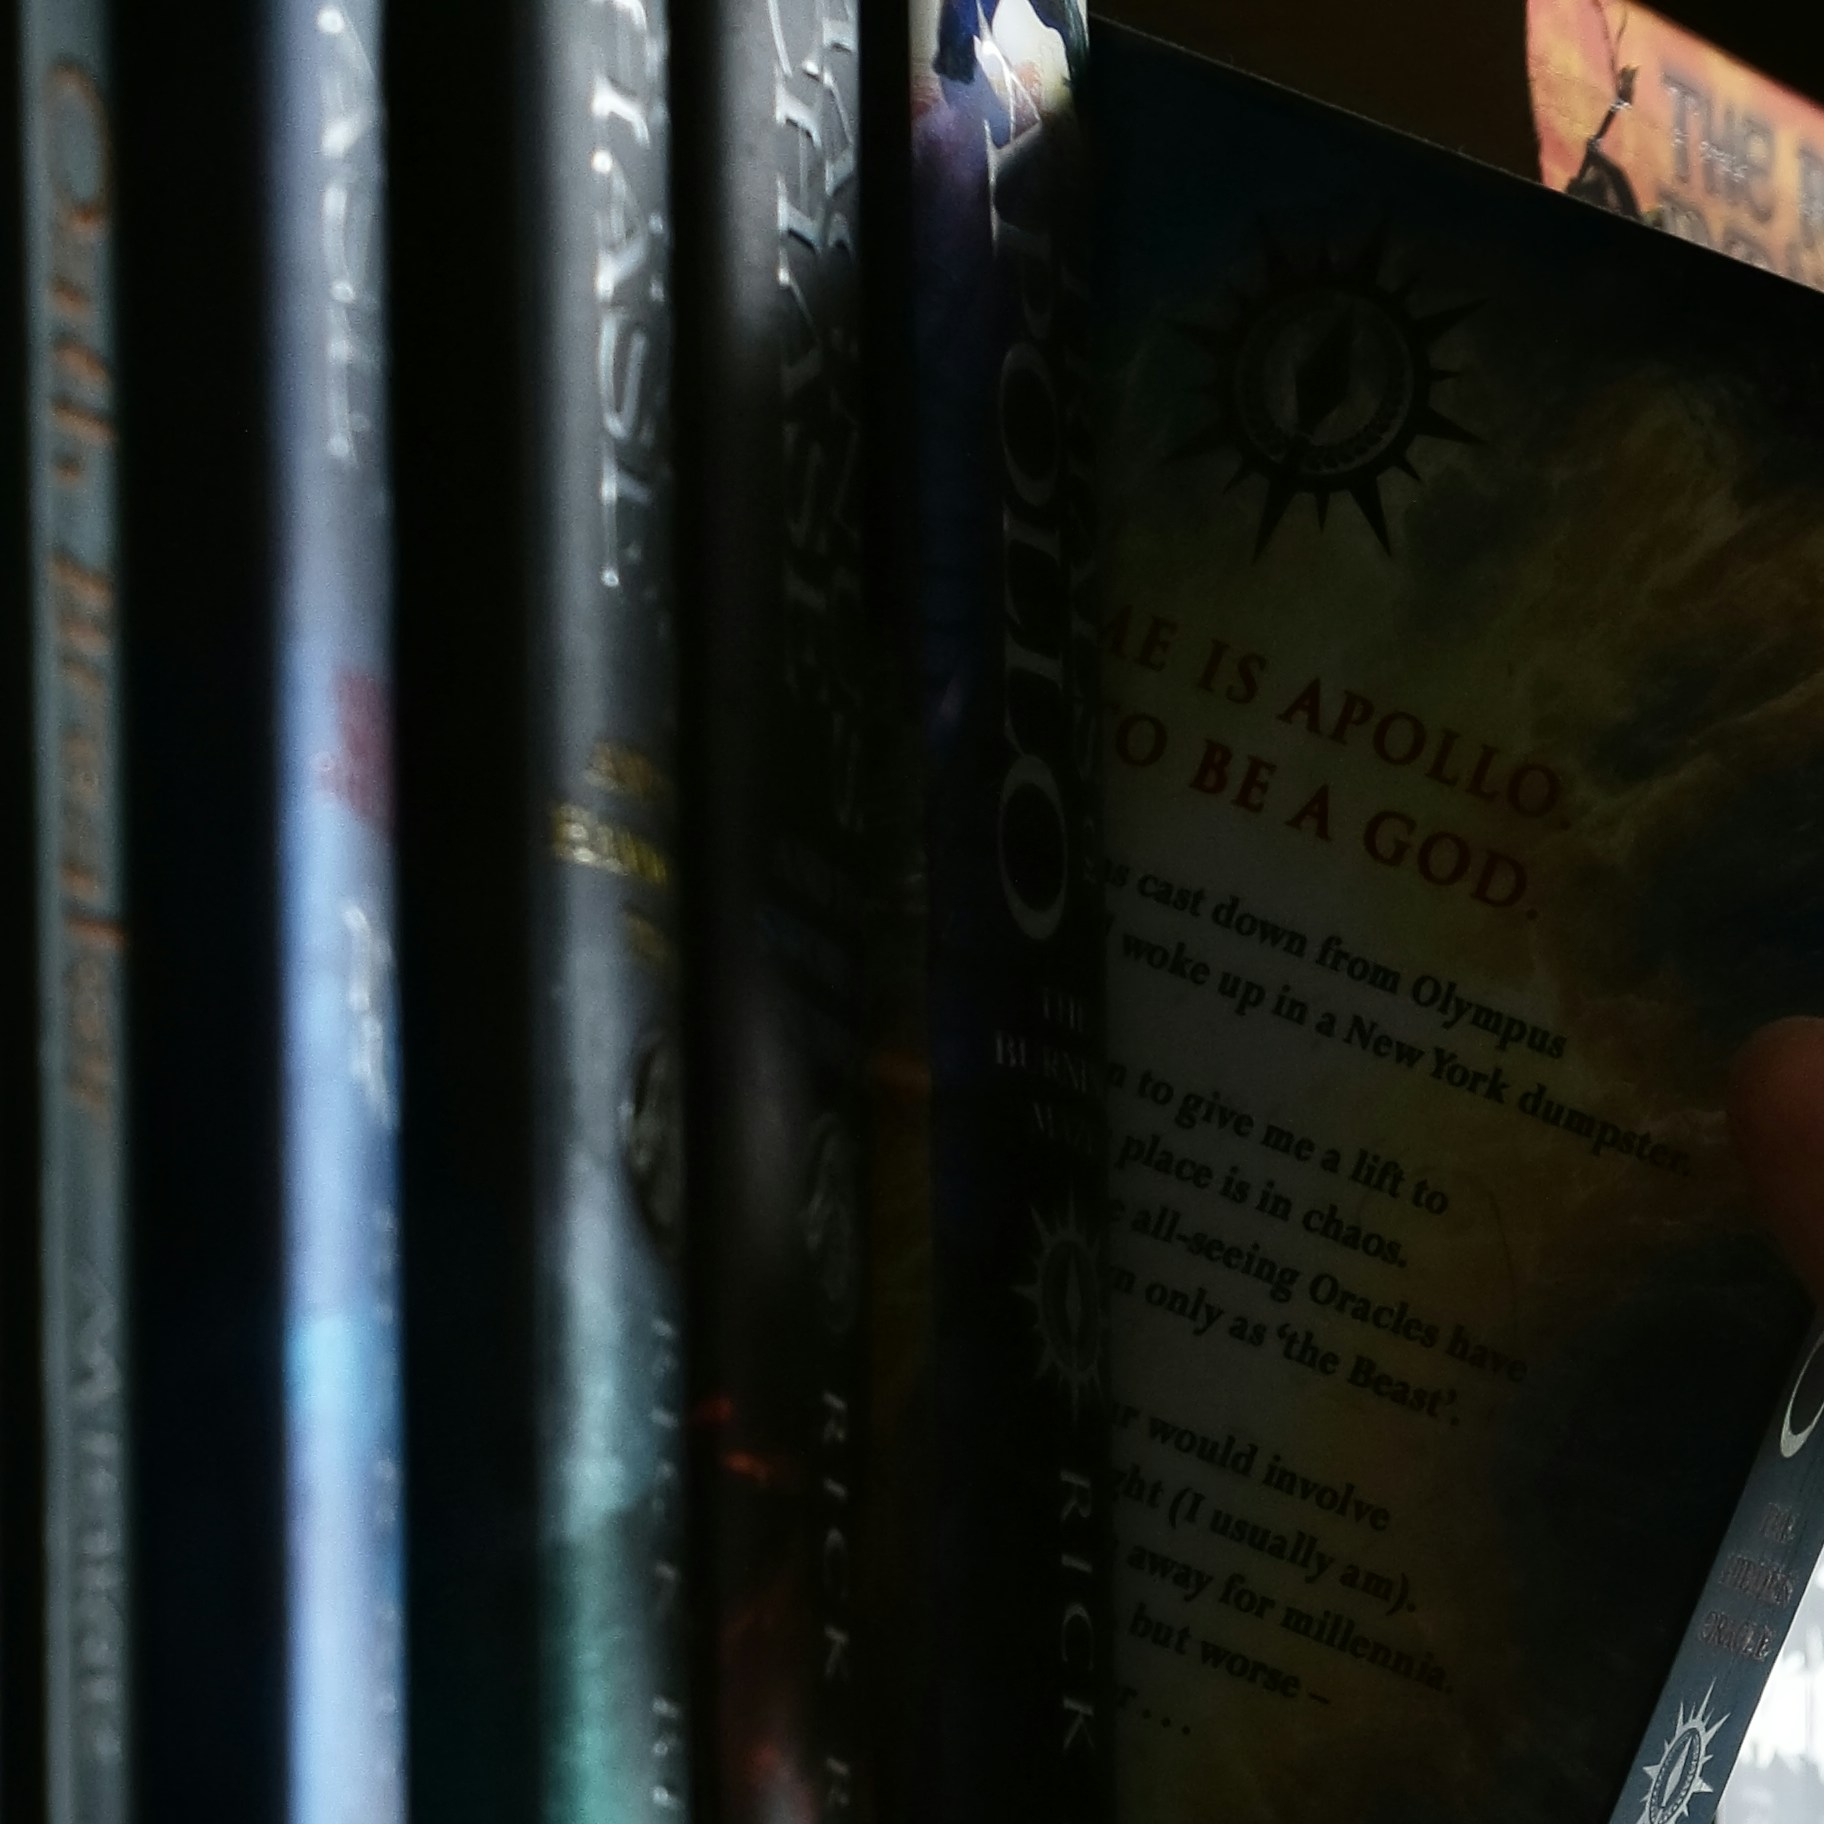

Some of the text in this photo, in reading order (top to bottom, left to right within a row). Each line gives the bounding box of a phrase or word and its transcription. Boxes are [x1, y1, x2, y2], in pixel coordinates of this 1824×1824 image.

[978, 30, 1070, 942] APOLLO
[1099, 604, 1573, 831] ME IS APOLLO.
[1188, 738, 1277, 813] BE
[1285, 783, 1334, 841] A
[1362, 810, 1539, 921] GOD.
[1121, 932, 1211, 986] woke
[1217, 970, 1267, 1017] up
[1272, 984, 1309, 1026] in
[1315, 1012, 1337, 1039] a
[1343, 1014, 1426, 1068] New
[1429, 1047, 1511, 1105] York
[1136, 873, 1205, 918] cast
[1211, 895, 1308, 958] down
[1315, 935, 1402, 995] from
[1411, 974, 1568, 1060] Olympus
[1114, 1132, 1409, 1270] place is in chaos.
[1138, 1068, 1175, 1106] to
[1174, 1089, 1256, 1138] give
[1260, 1119, 1316, 1163] me
[1320, 1147, 1343, 1176] a
[1348, 1147, 1407, 1200] lift
[1412, 1177, 1450, 1217] to
[1129, 1203, 1529, 1385] all-seeing Oracles have
[1144, 1280, 1225, 1337] only
[1228, 1313, 1267, 1349] as
[820, 1390, 851, 1683] RICK
[1147, 1413, 1260, 1478] would
[1262, 1453, 1392, 1534] involve
[1059, 1468, 1097, 1756] RICK
[1126, 1542, 1455, 1696] away for millennia.
[1208, 1504, 1337, 1585] usually
[1338, 1558, 1418, 1618] am).
[1126, 1601, 1193, 1656] but
[1199, 1638, 1302, 1699] worse
